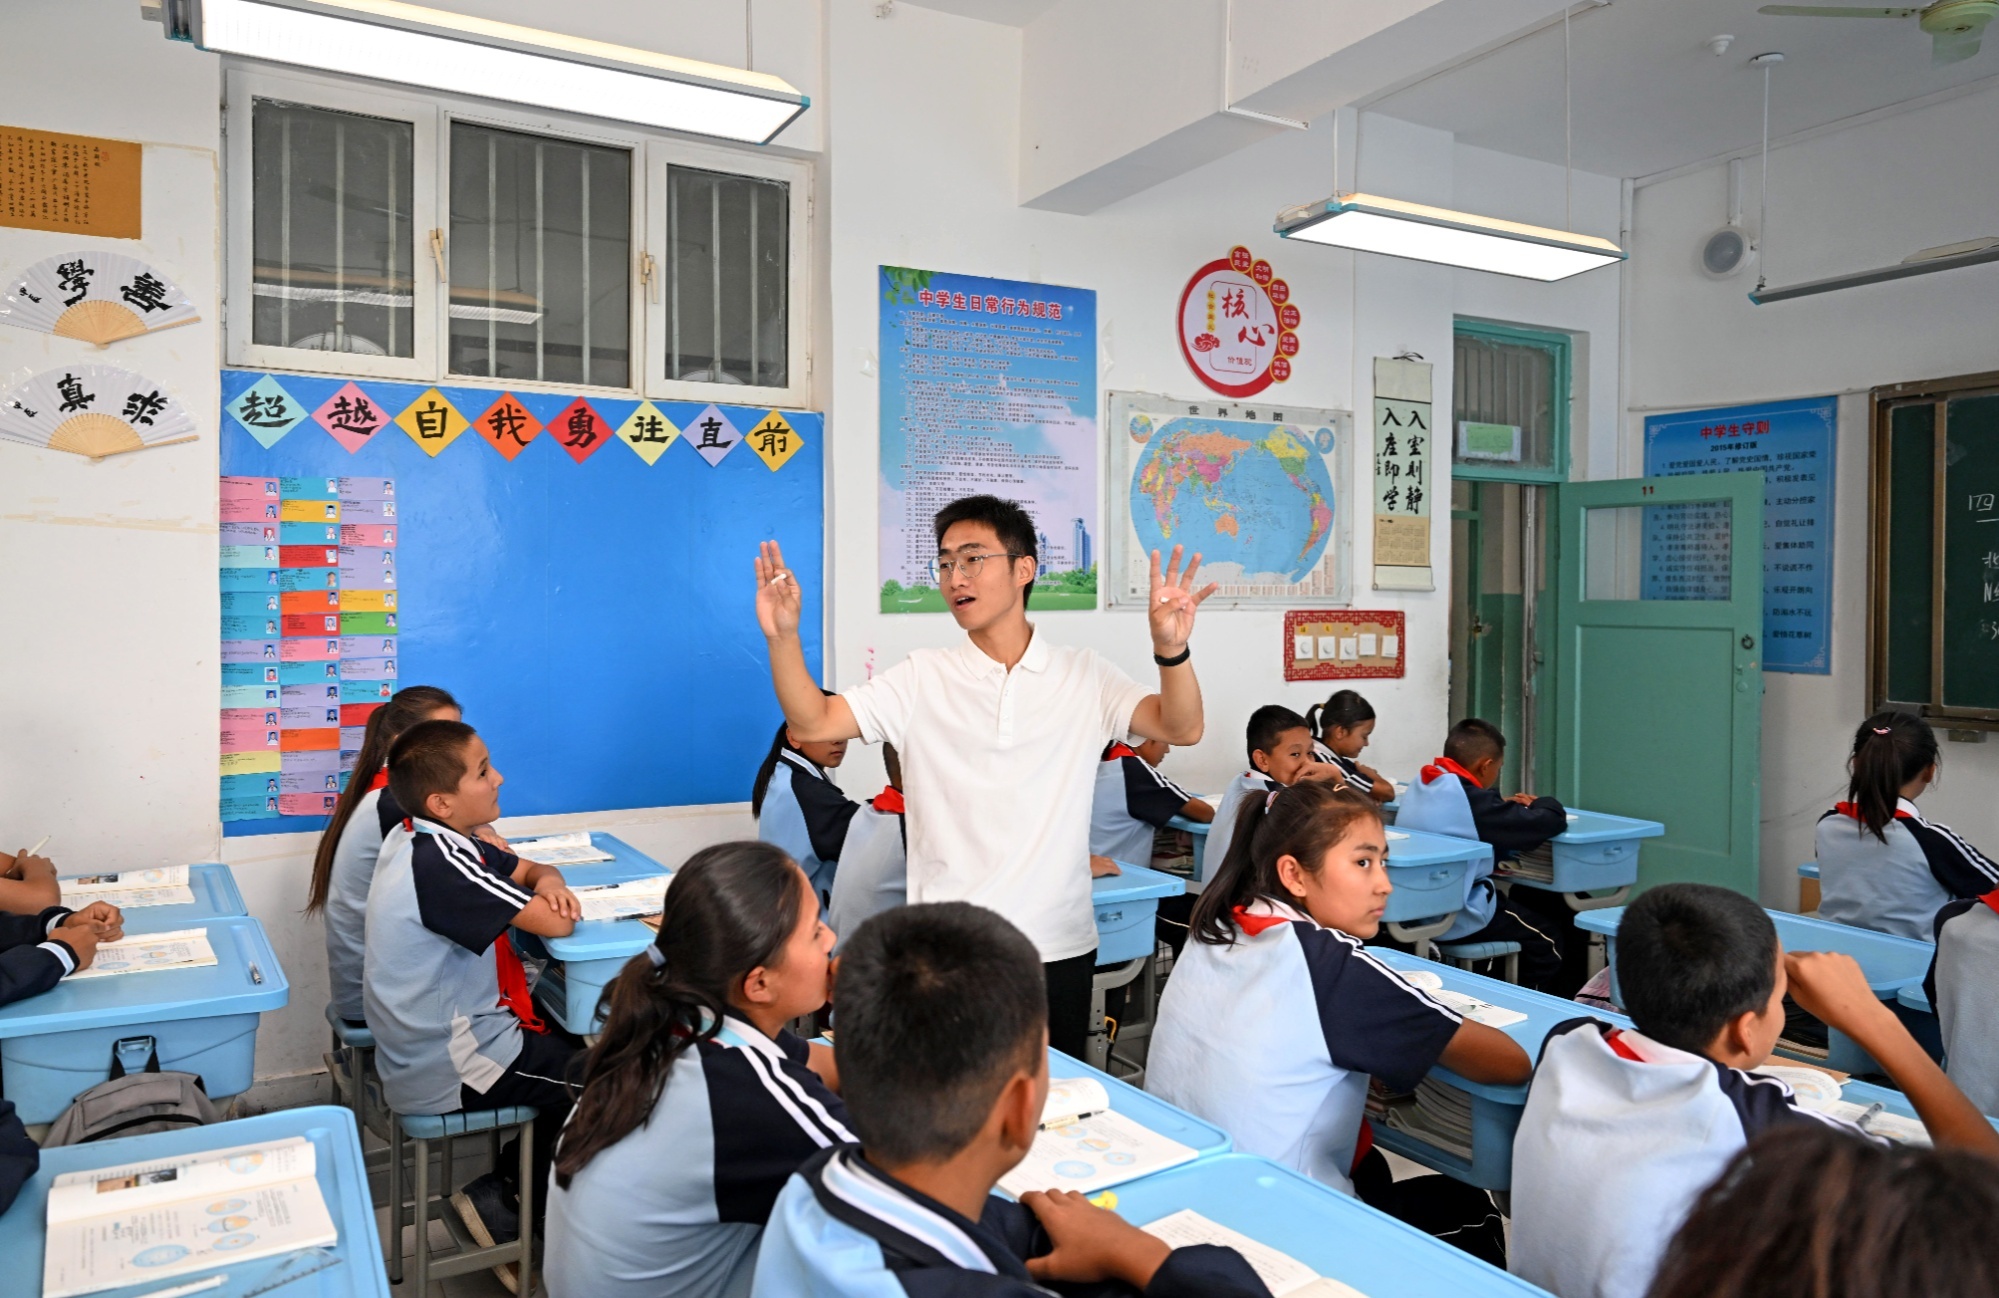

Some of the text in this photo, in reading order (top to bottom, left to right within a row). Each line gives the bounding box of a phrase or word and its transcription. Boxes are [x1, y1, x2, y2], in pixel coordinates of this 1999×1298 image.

[919, 289, 1063, 320] 中学生日常行为规范
[1188, 405, 1283, 422] 世界地图
[1700, 420, 1771, 439] 中学生守则
[1641, 486, 1655, 496] 11
